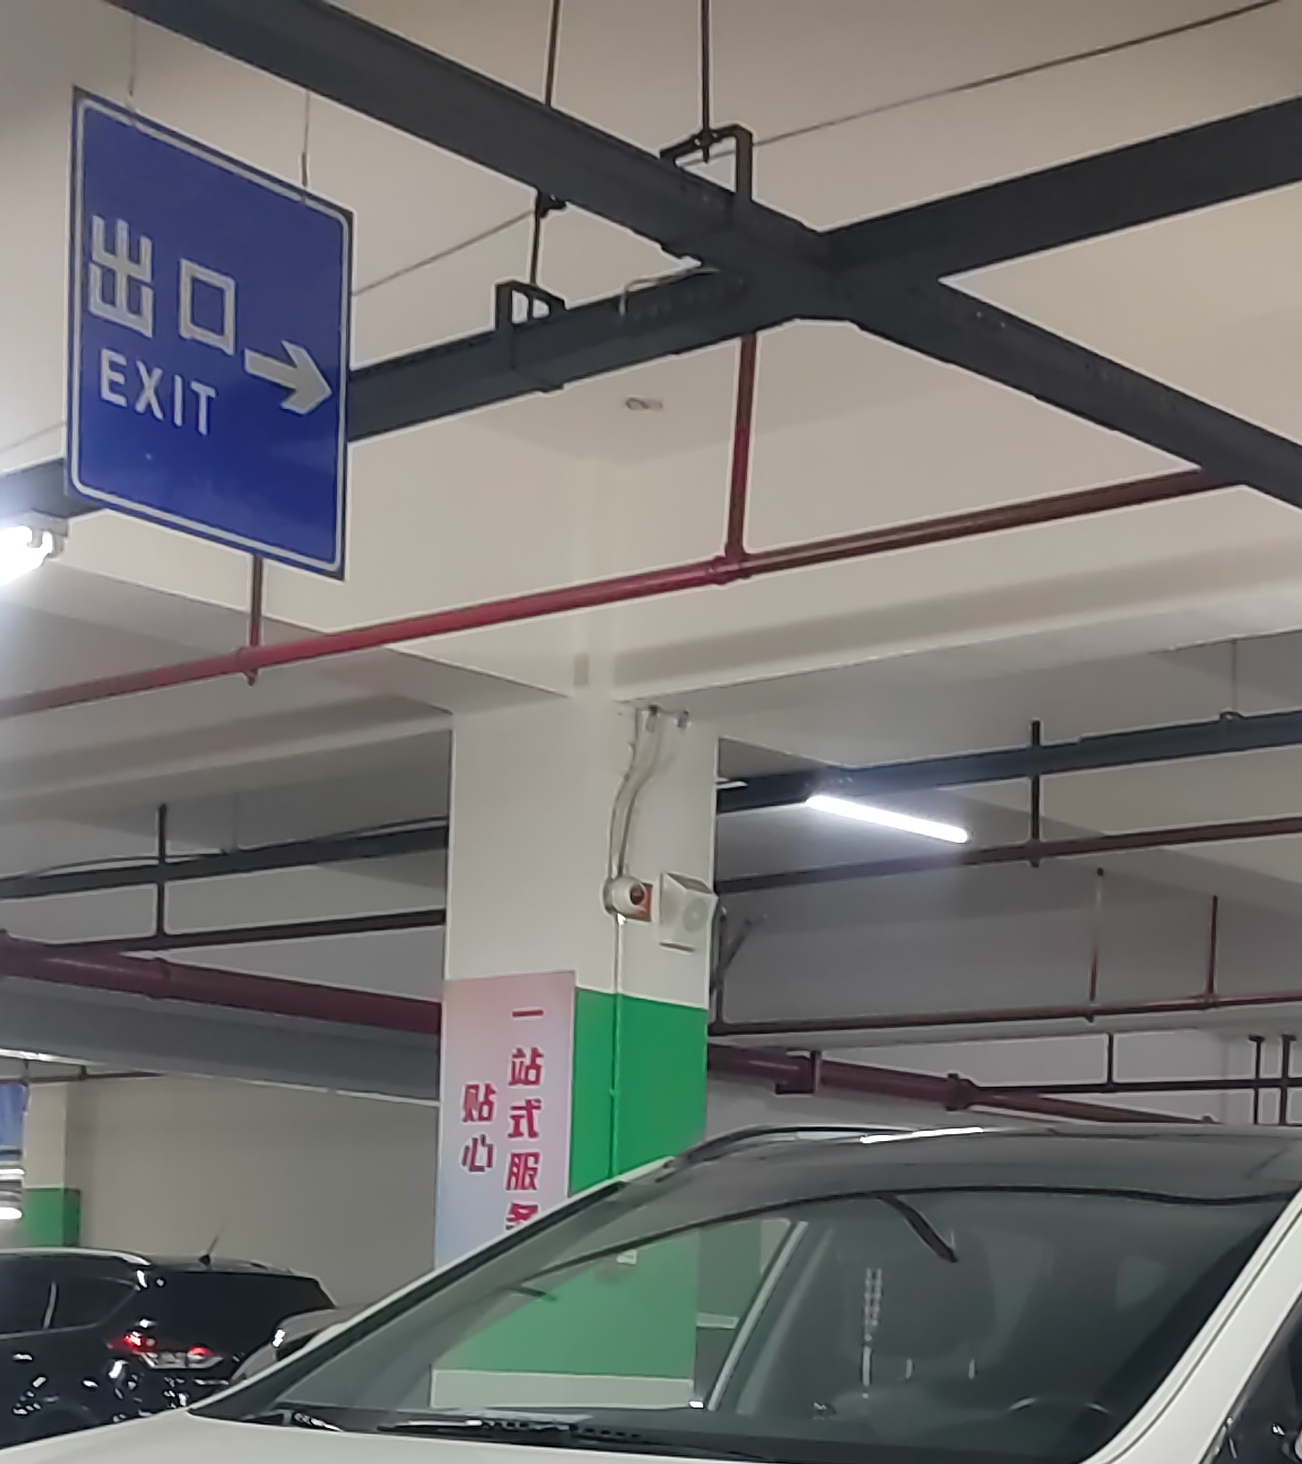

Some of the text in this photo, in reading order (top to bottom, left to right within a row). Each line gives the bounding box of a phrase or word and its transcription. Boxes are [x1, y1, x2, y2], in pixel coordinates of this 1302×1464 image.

[89, 214, 237, 356] 出口
[100, 348, 217, 436] EXIT
[460, 1083, 498, 1173] 贴心
